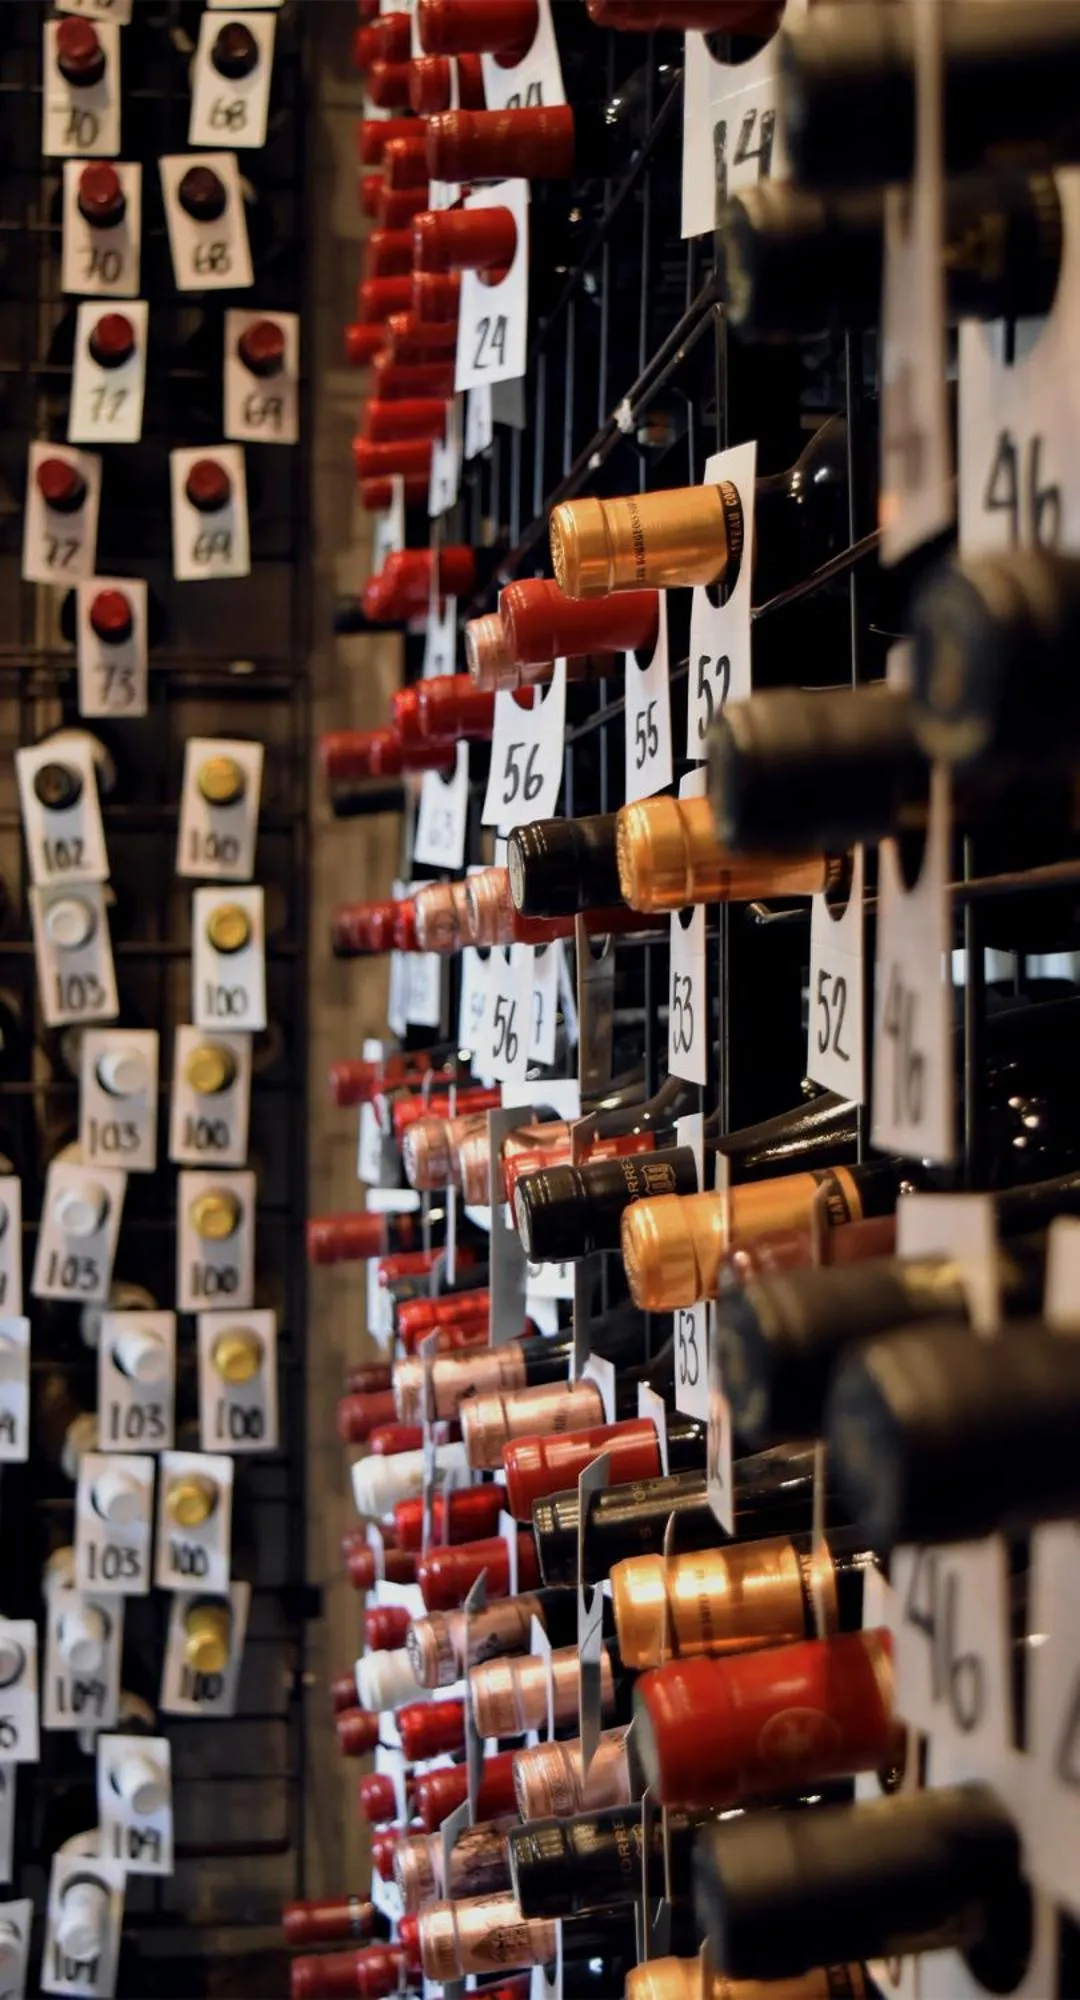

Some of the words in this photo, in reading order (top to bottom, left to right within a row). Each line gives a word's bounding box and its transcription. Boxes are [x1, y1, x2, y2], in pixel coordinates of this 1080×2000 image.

[53, 104, 99, 148] 70
[208, 98, 247, 132] 68
[78, 247, 122, 285] 70
[193, 242, 231, 275] 68
[474, 316, 508, 370] 24
[635, 700, 658, 770] 55
[503, 742, 544, 805] 56
[55, 971, 106, 1012] 103
[206, 983, 248, 1018] 100
[493, 994, 518, 1064] 56
[673, 971, 694, 1054] 53
[817, 968, 850, 1061] 52
[90, 1117, 140, 1156] 103
[184, 1115, 228, 1152] 100
[46, 1250, 99, 1290] 103
[191, 1261, 238, 1297] 100
[679, 1310, 699, 1387] 53
[110, 1400, 166, 1441] 103
[216, 1397, 264, 1440] 100
[86, 1541, 142, 1582] 103
[906, 1545, 983, 1734] 46
